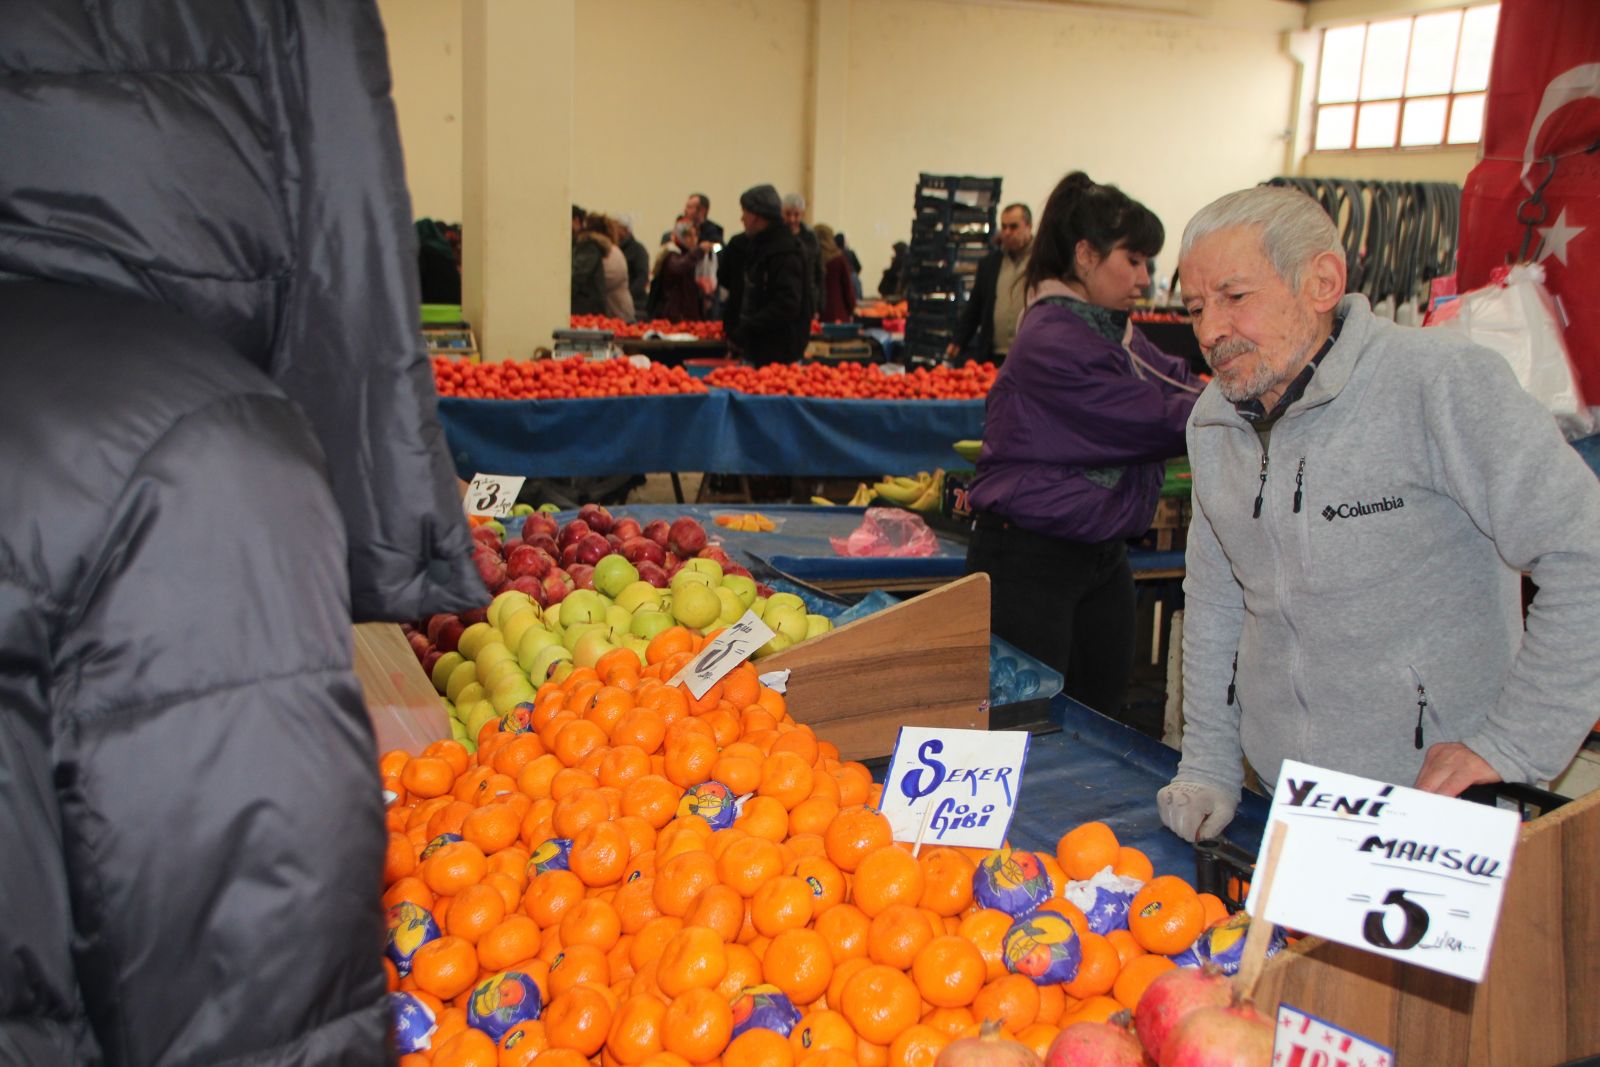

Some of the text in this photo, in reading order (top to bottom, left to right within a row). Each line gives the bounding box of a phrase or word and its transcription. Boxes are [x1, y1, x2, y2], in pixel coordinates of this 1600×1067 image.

[477, 484, 500, 510] 3
[1337, 497, 1405, 519] Columbia
[1363, 888, 1437, 950] 5
